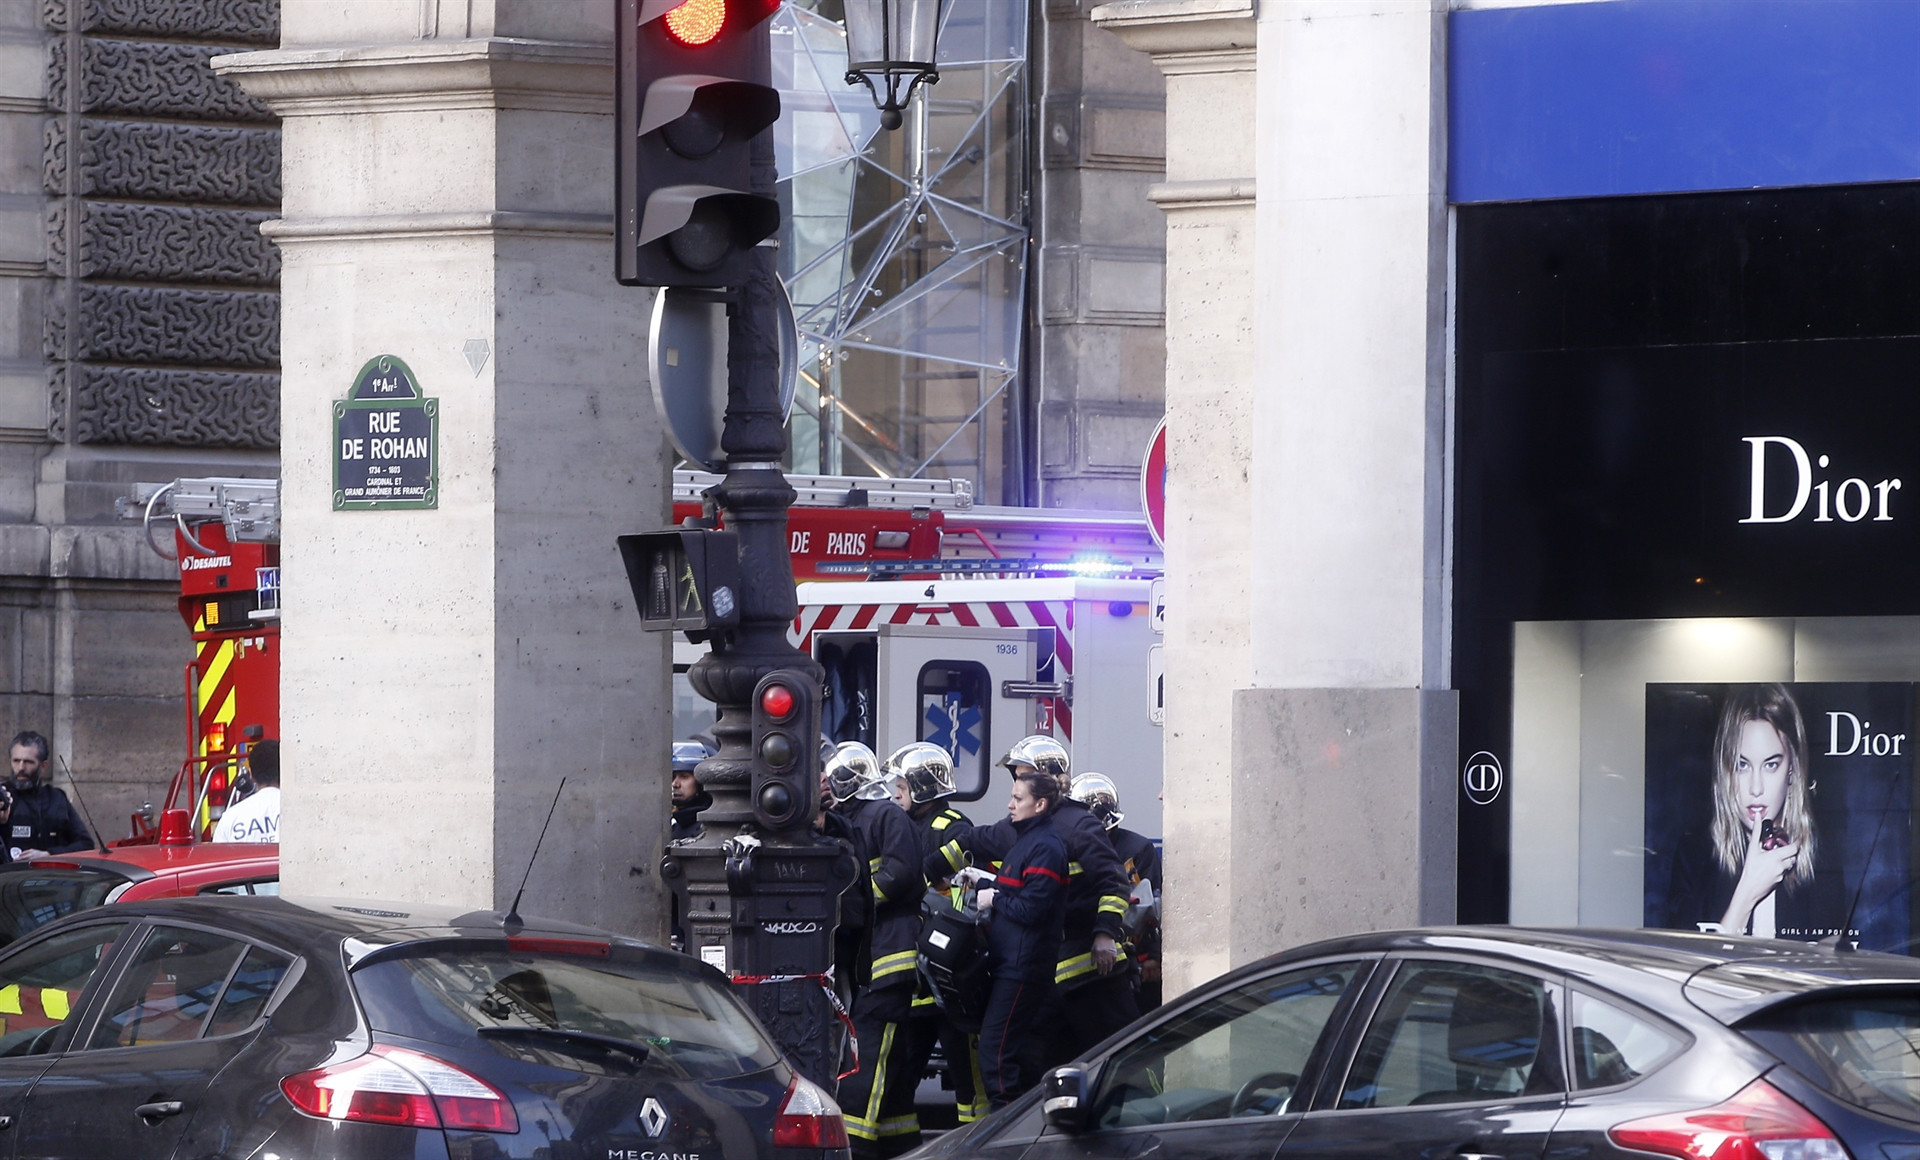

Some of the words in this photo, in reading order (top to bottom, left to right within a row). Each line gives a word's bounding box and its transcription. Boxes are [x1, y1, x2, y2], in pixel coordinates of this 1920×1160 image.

[369, 412, 401, 433] RUE
[342, 438, 364, 459] DE
[370, 437, 428, 459] ROHAN
[368, 466, 381, 474] 1734
[366, 477, 393, 486] CARDINAL
[394, 477, 403, 486] ET
[1739, 437, 1902, 524] Dior
[344, 487, 364, 496] GRAND
[393, 487, 401, 495] DE
[402, 486, 425, 495] FRANCE
[790, 531, 811, 553] DE
[826, 532, 866, 556] PARIS
[193, 556, 232, 569] DESAUTEL
[996, 644, 1018, 655] 1936
[1825, 712, 1905, 756] Dior
